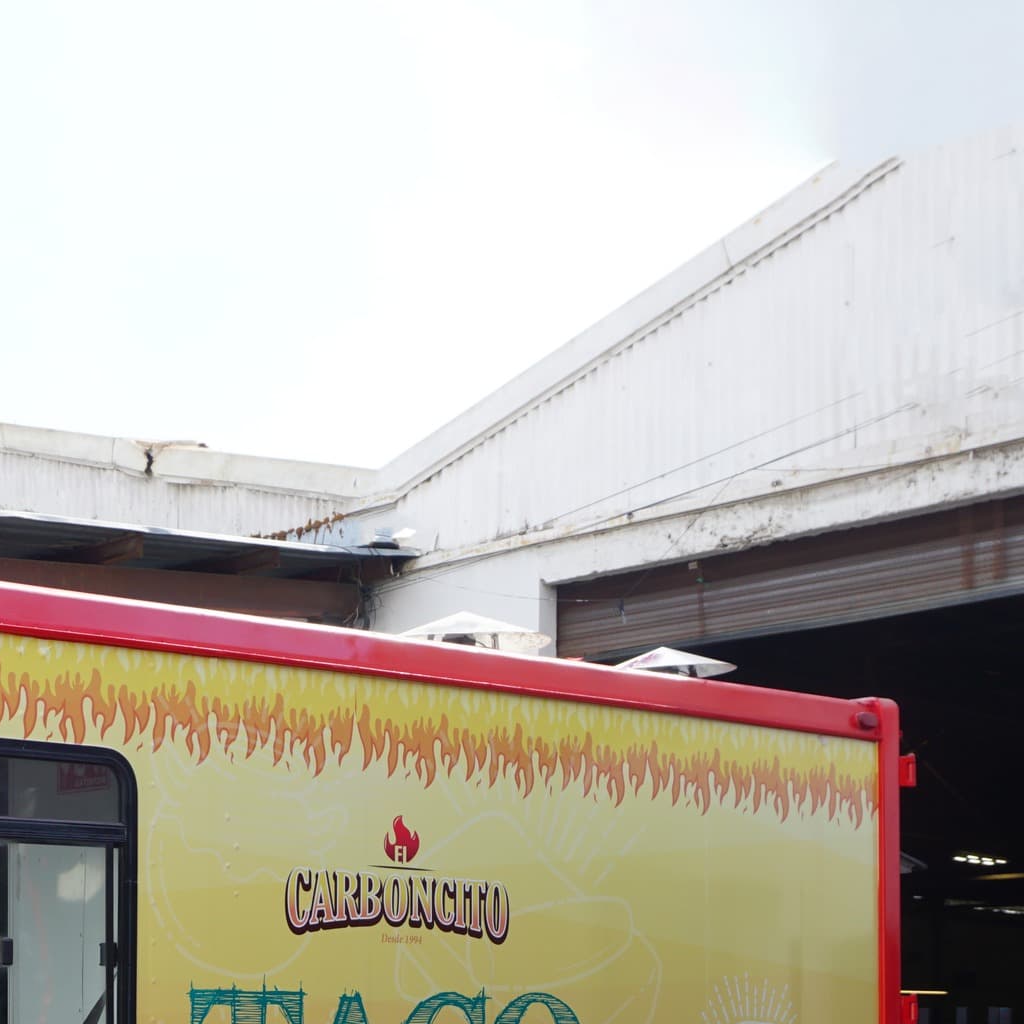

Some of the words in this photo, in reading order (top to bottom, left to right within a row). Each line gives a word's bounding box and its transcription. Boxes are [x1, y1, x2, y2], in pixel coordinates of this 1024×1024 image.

[284, 866, 509, 945] CARBONCITO
[381, 933, 403, 944] Desde
[406, 935, 422, 944] 1994
